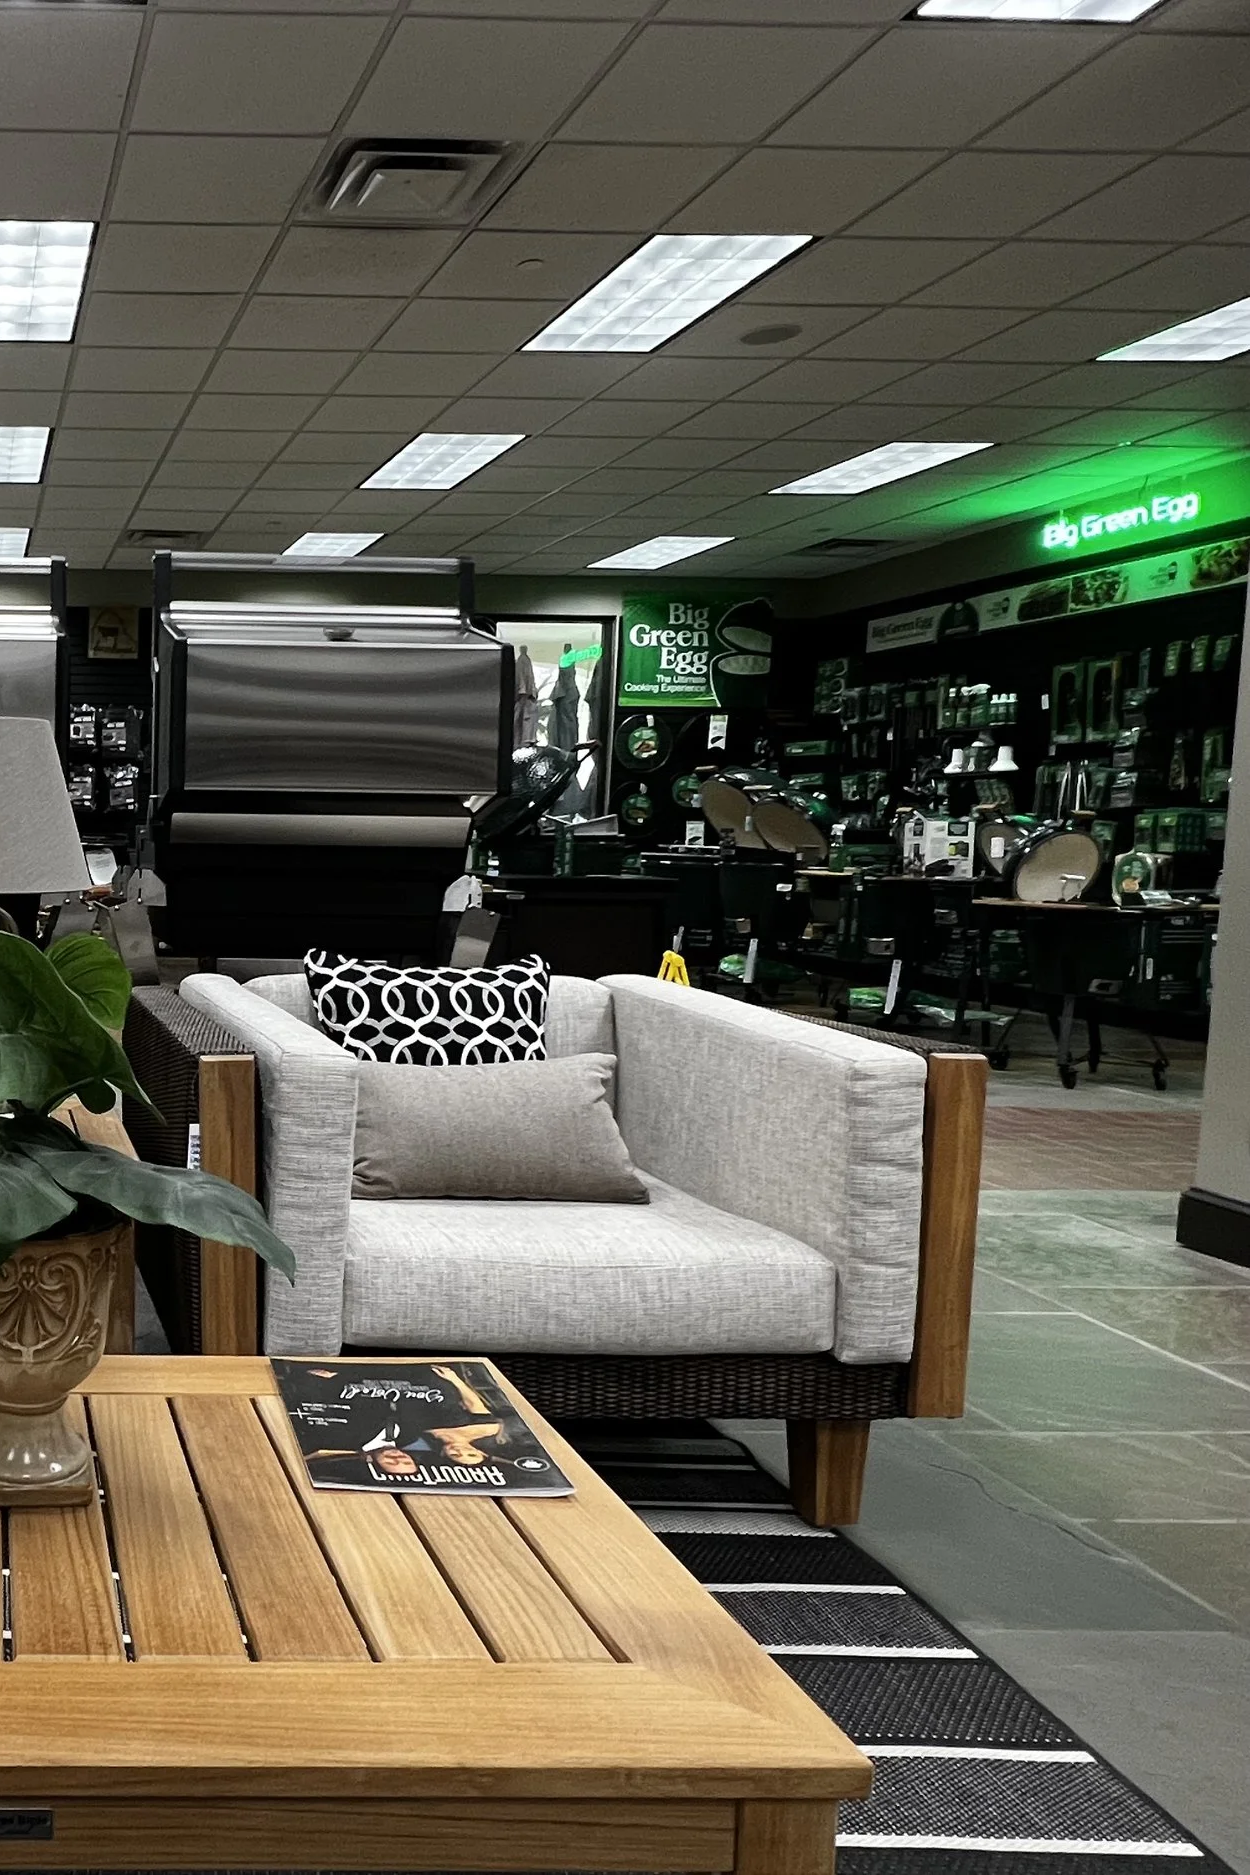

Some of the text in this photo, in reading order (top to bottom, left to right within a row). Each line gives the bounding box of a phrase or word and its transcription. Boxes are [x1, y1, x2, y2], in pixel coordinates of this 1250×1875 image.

[1042, 493, 1199, 548] Big Green Egg
[668, 603, 710, 630] Big
[629, 624, 710, 647] Green
[659, 647, 709, 675] Egg
[624, 682, 707, 693] Cooking Experience
[656, 674, 671, 684] The
